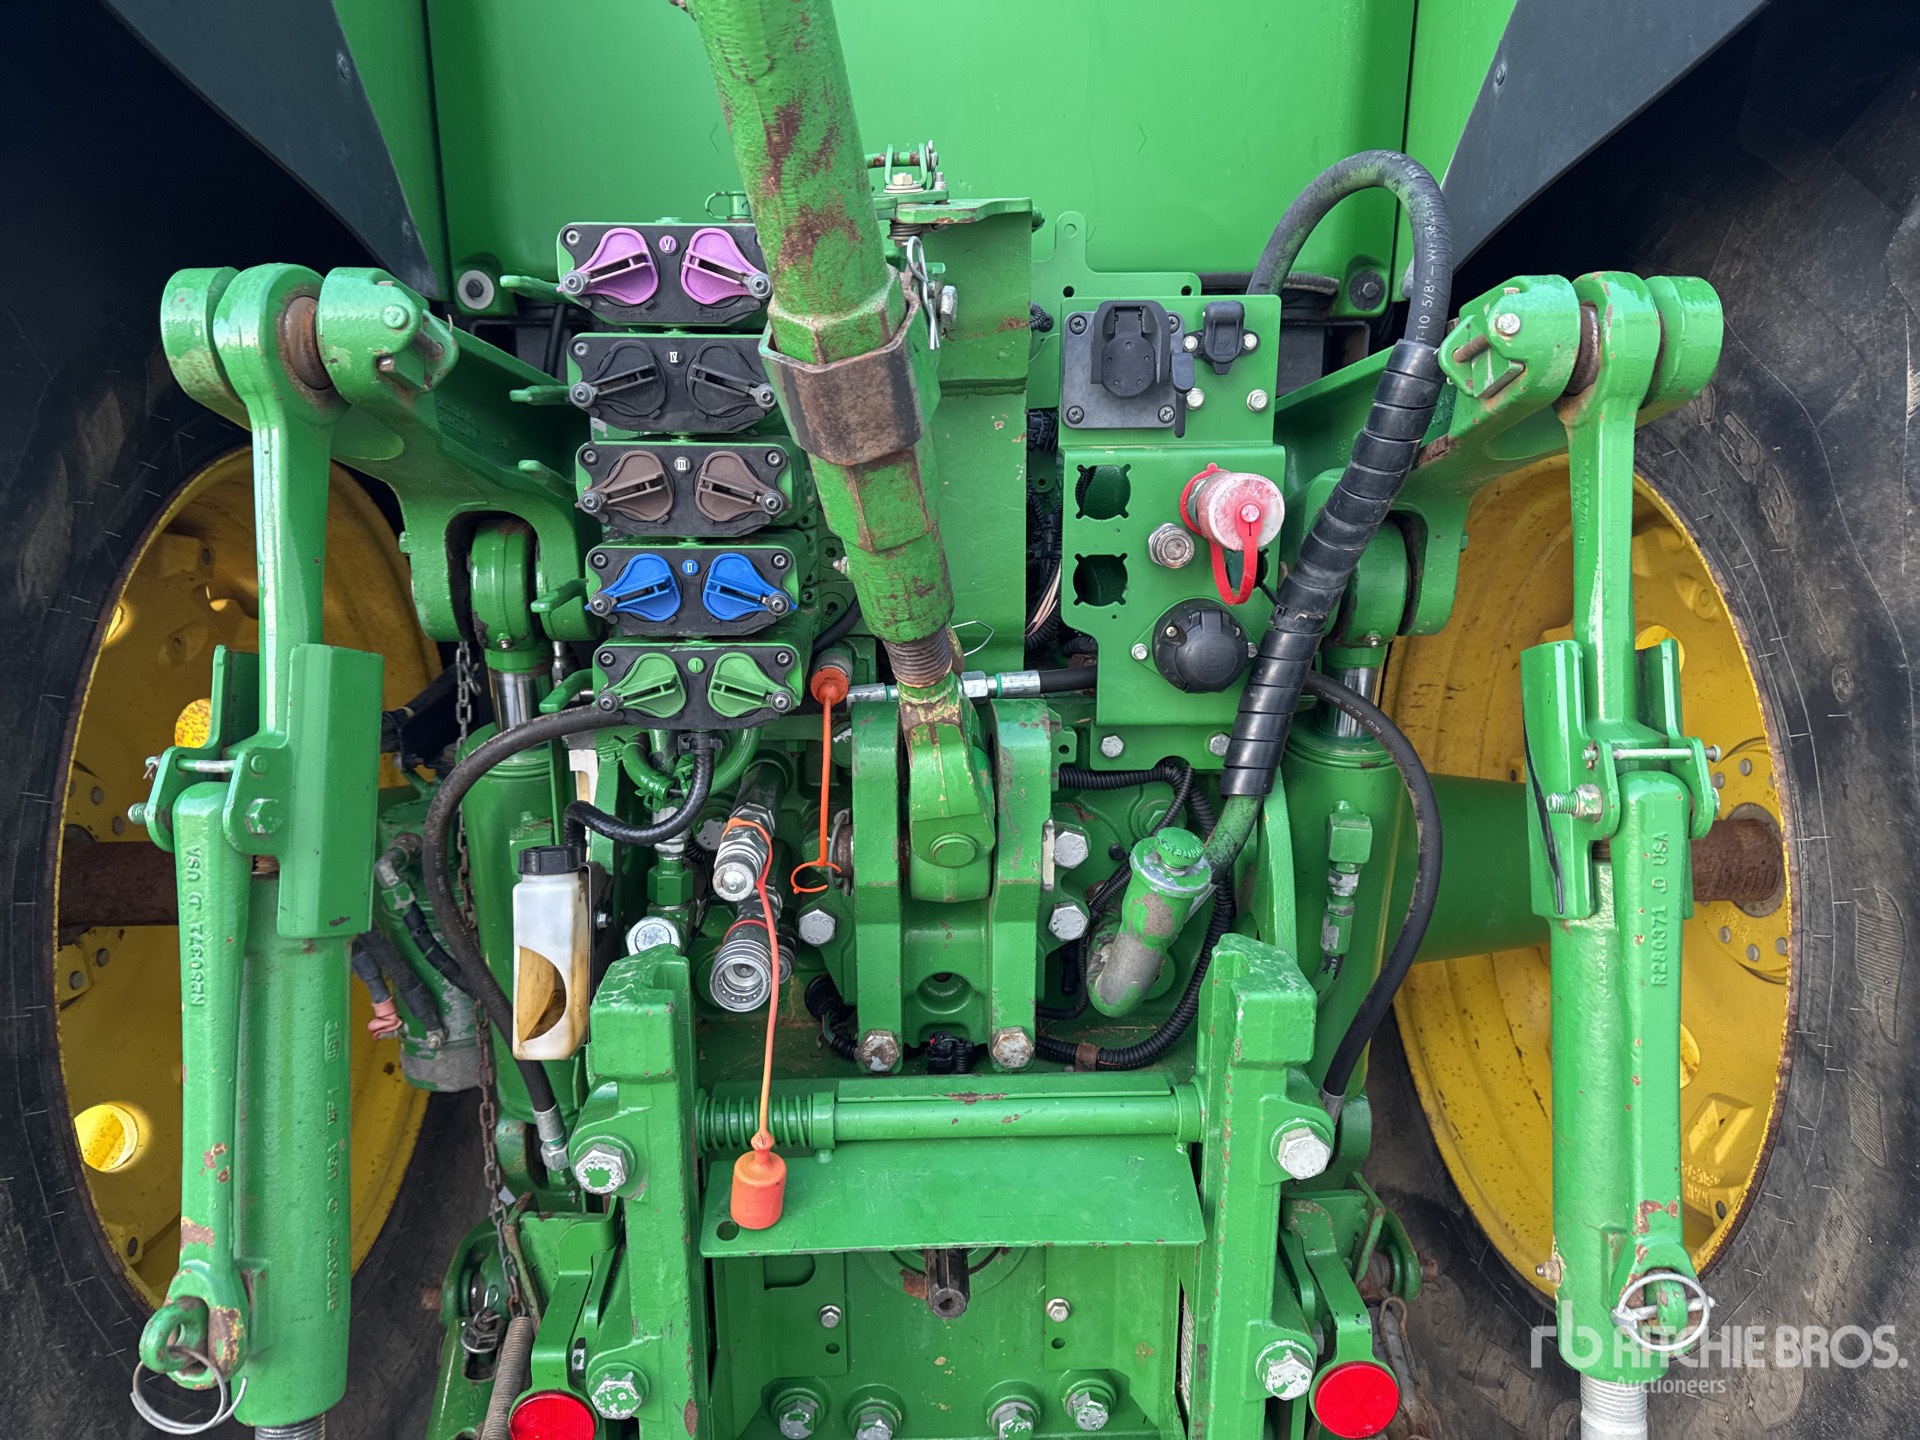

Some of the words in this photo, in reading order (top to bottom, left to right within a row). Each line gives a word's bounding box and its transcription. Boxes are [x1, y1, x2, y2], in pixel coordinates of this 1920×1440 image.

[676, 459, 687, 471] III
[186, 845, 201, 883] USA
[1652, 831, 1668, 867] USA
[1650, 905, 1667, 986] R280371
